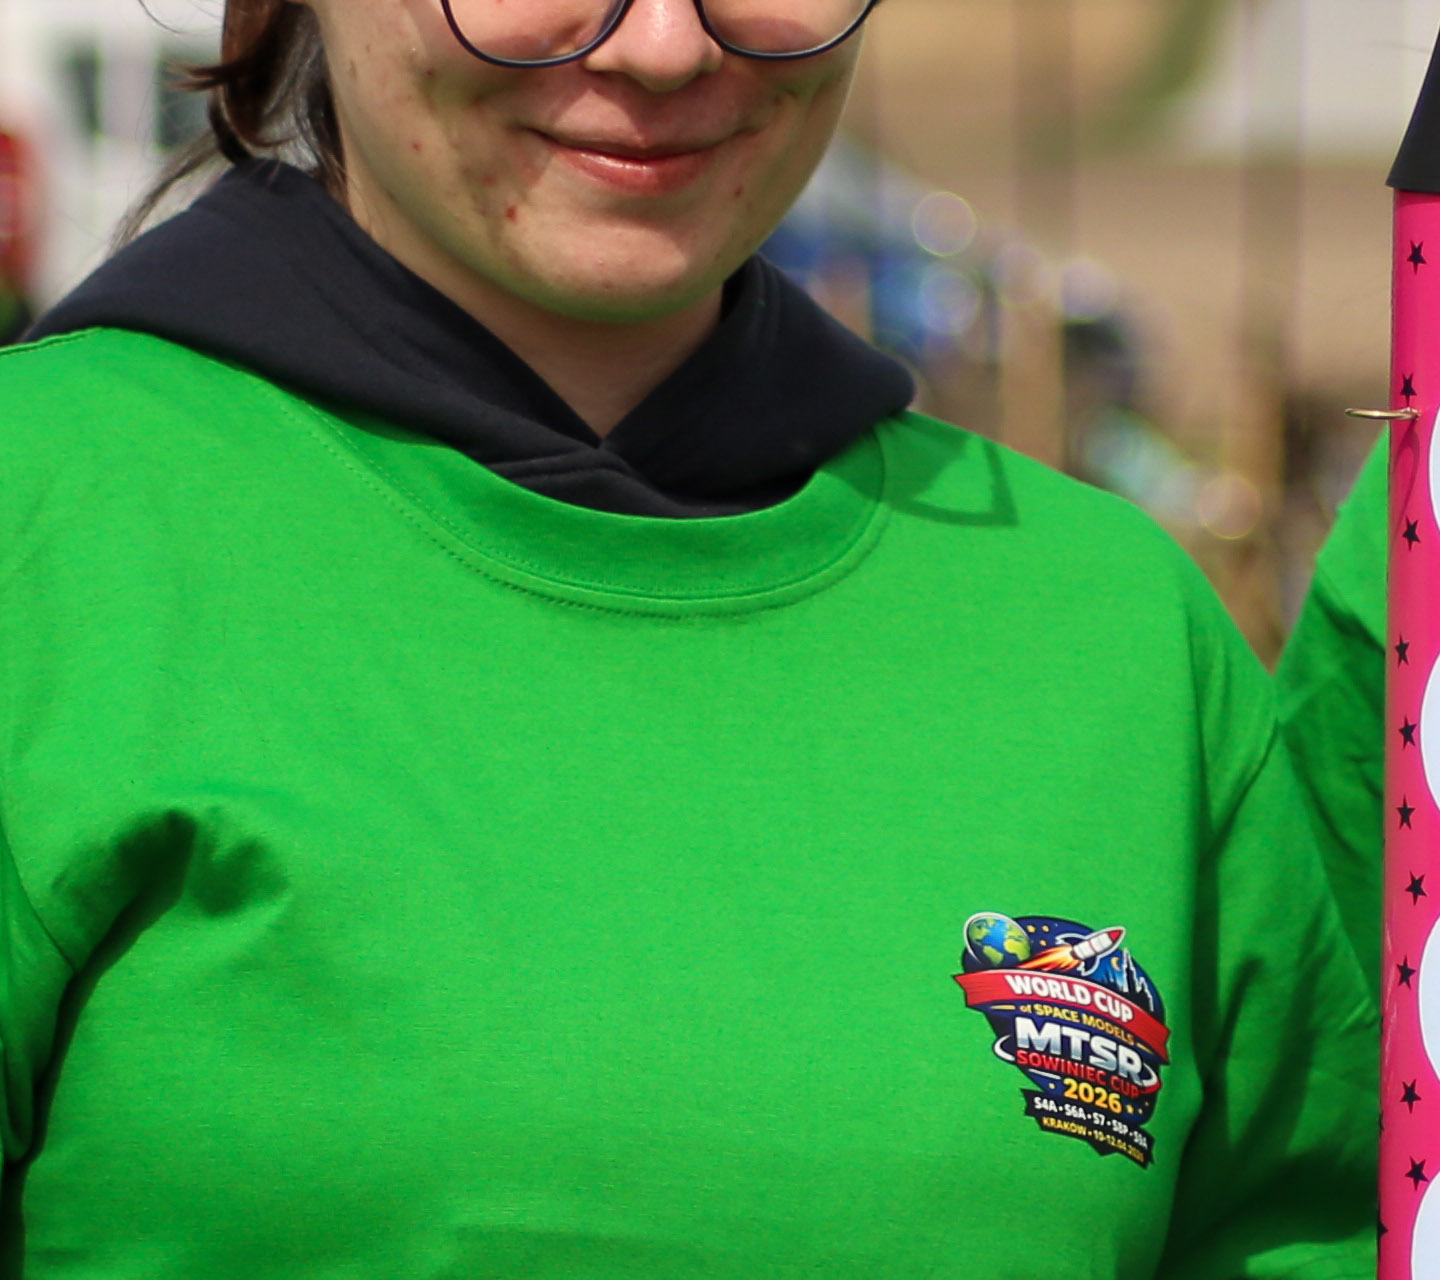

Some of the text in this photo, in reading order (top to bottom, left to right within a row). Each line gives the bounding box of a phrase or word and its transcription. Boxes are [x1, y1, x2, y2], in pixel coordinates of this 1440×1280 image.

[1005, 975, 1134, 1023] WORLD CUP
[1020, 1004, 1135, 1045] of SPACE MODELS
[1015, 1017, 1143, 1085] MTSR
[1016, 1049, 1141, 1098] SOWINIEC CUP
[1063, 1078, 1123, 1113] 2026
[1033, 1097, 1058, 1113] S4A
[1092, 1112, 1105, 1126] S7
